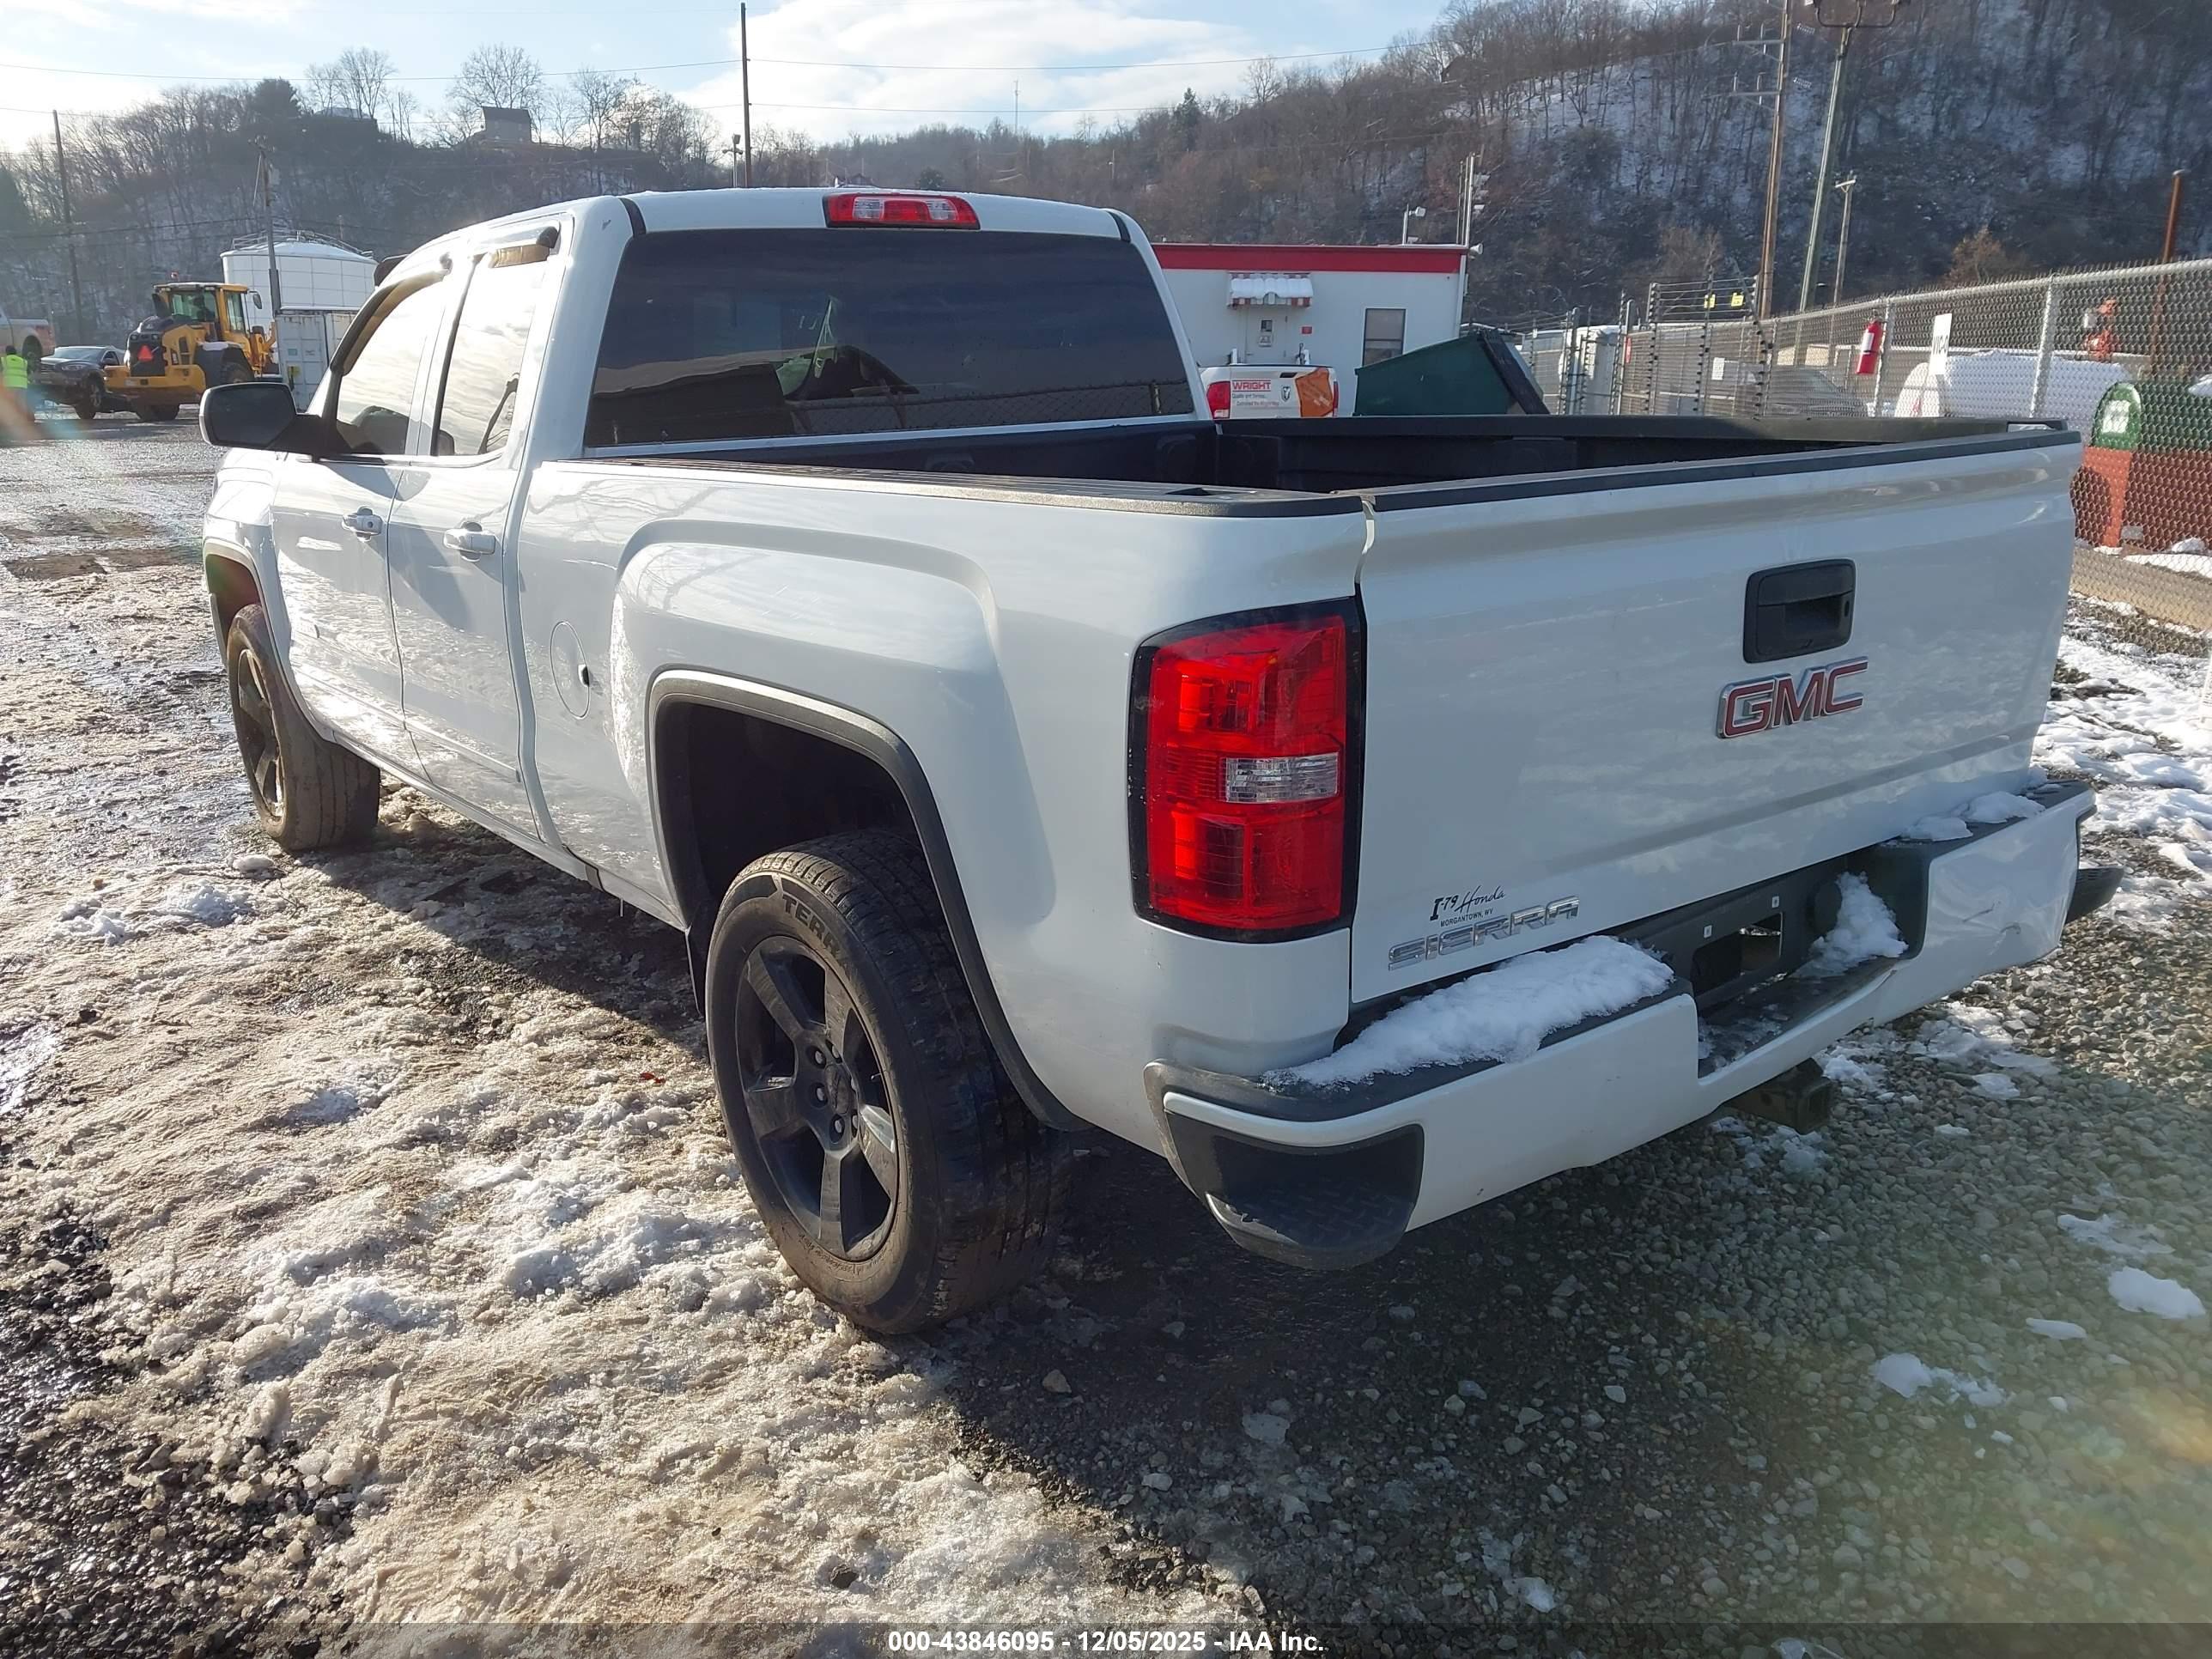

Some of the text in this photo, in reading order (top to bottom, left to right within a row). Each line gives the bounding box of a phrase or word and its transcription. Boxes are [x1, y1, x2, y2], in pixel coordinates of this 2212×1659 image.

[1232, 381, 1271, 390] WRIGHT
[1717, 655, 1869, 738] GMC
[1430, 884, 1505, 921] I-79 Honda
[1389, 895, 1580, 971] SIERRA
